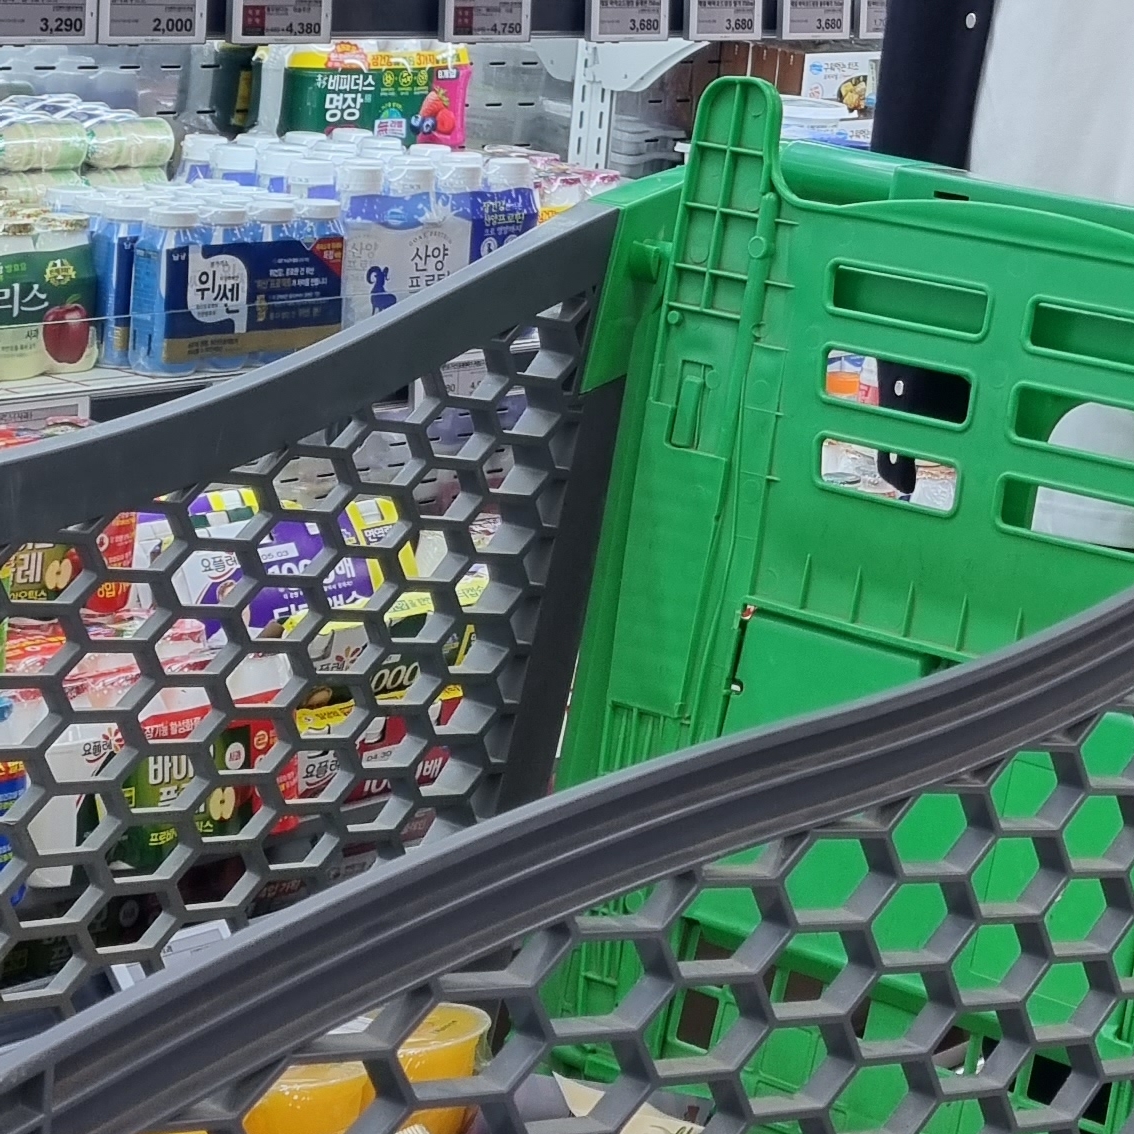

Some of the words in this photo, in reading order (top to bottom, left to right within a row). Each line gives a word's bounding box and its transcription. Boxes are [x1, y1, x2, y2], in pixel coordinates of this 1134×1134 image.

[40, 17, 83, 33] 3,290
[153, 17, 193, 33] 2,000
[286, 22, 321, 36] 4,380
[491, 22, 522, 35] 4,750
[629, 18, 659, 31] 3,680
[725, 18, 753, 31] 3,680
[816, 17, 842, 31] 3,680
[328, 73, 376, 92] 비피더스
[324, 93, 361, 123] 명장
[411, 243, 449, 272] 산양
[261, 549, 290, 561] 05.03
[144, 723, 169, 740] 장기능
